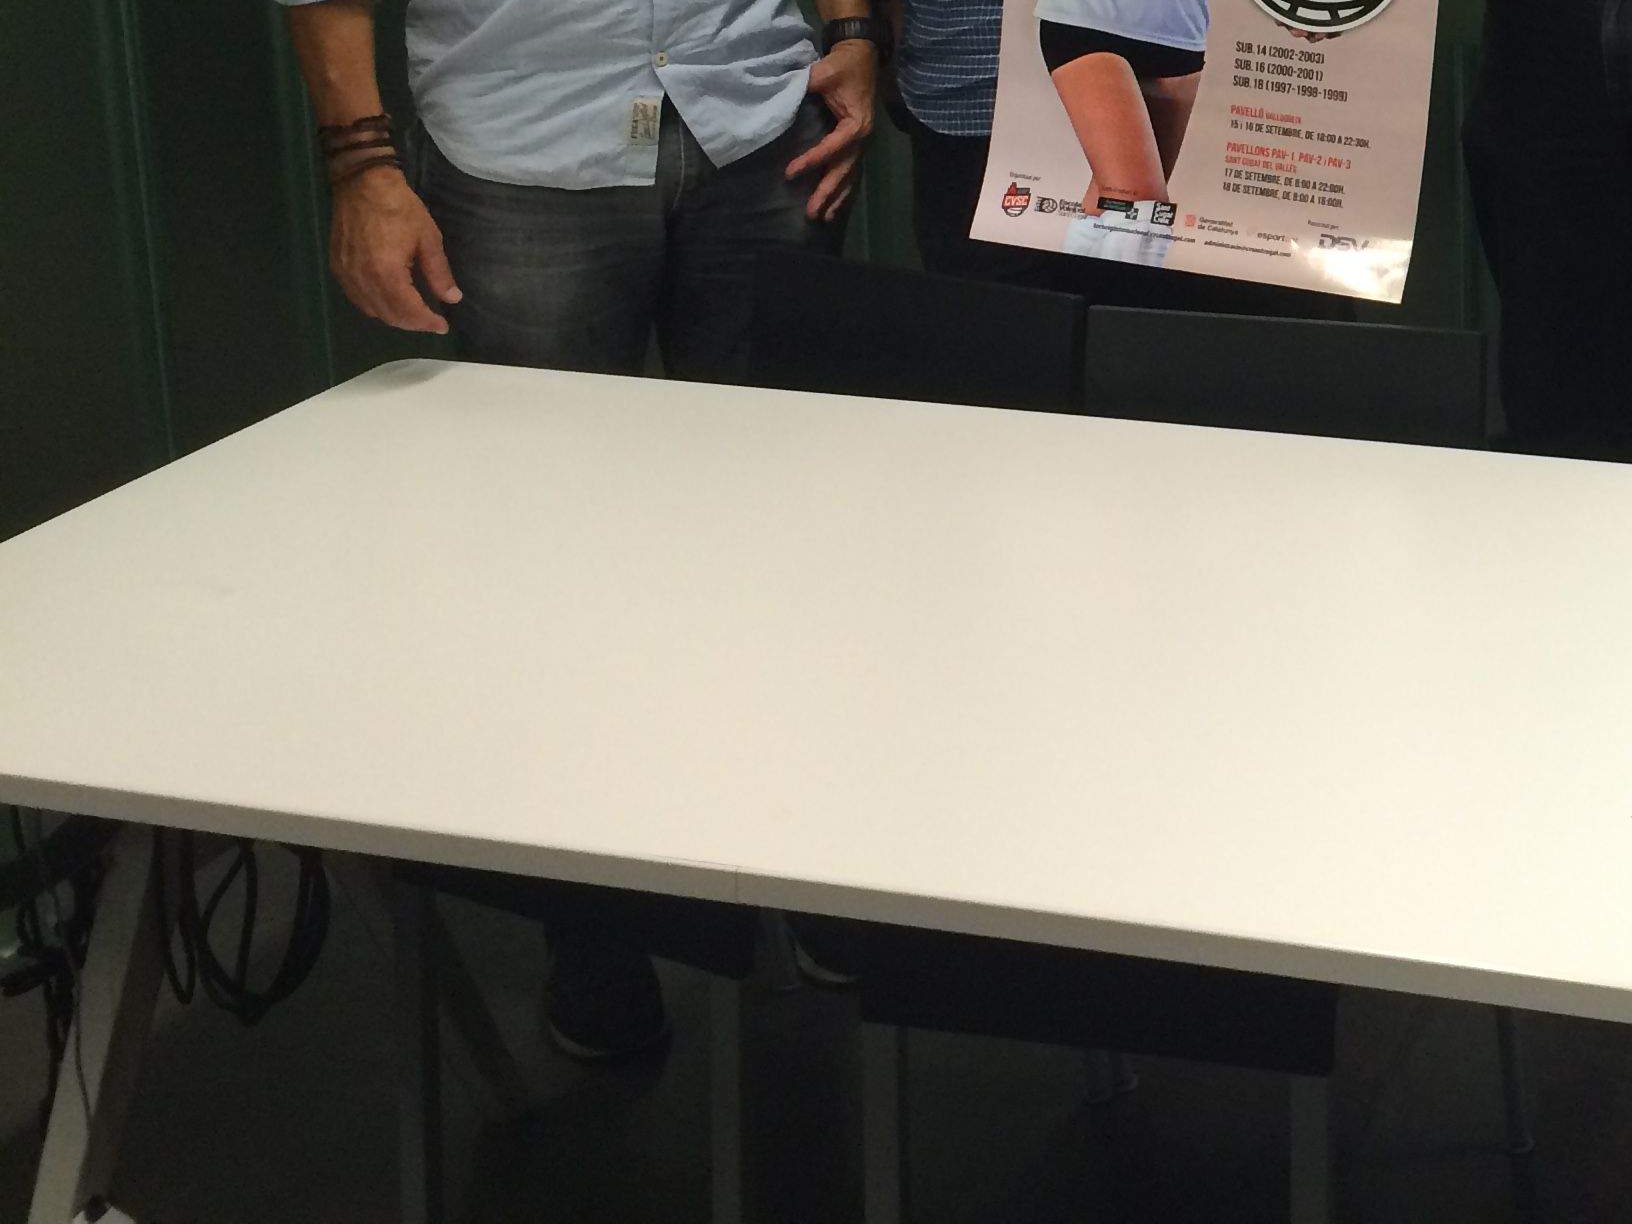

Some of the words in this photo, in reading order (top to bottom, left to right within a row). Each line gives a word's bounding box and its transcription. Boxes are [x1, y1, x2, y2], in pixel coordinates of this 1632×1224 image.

[1235, 41, 1254, 54] SUB.
[1256, 43, 1266, 56] 14
[1233, 57, 1253, 71] SUB.
[1255, 60, 1265, 73] 16
[1232, 75, 1252, 89] SUB.
[1253, 78, 1264, 90] 18
